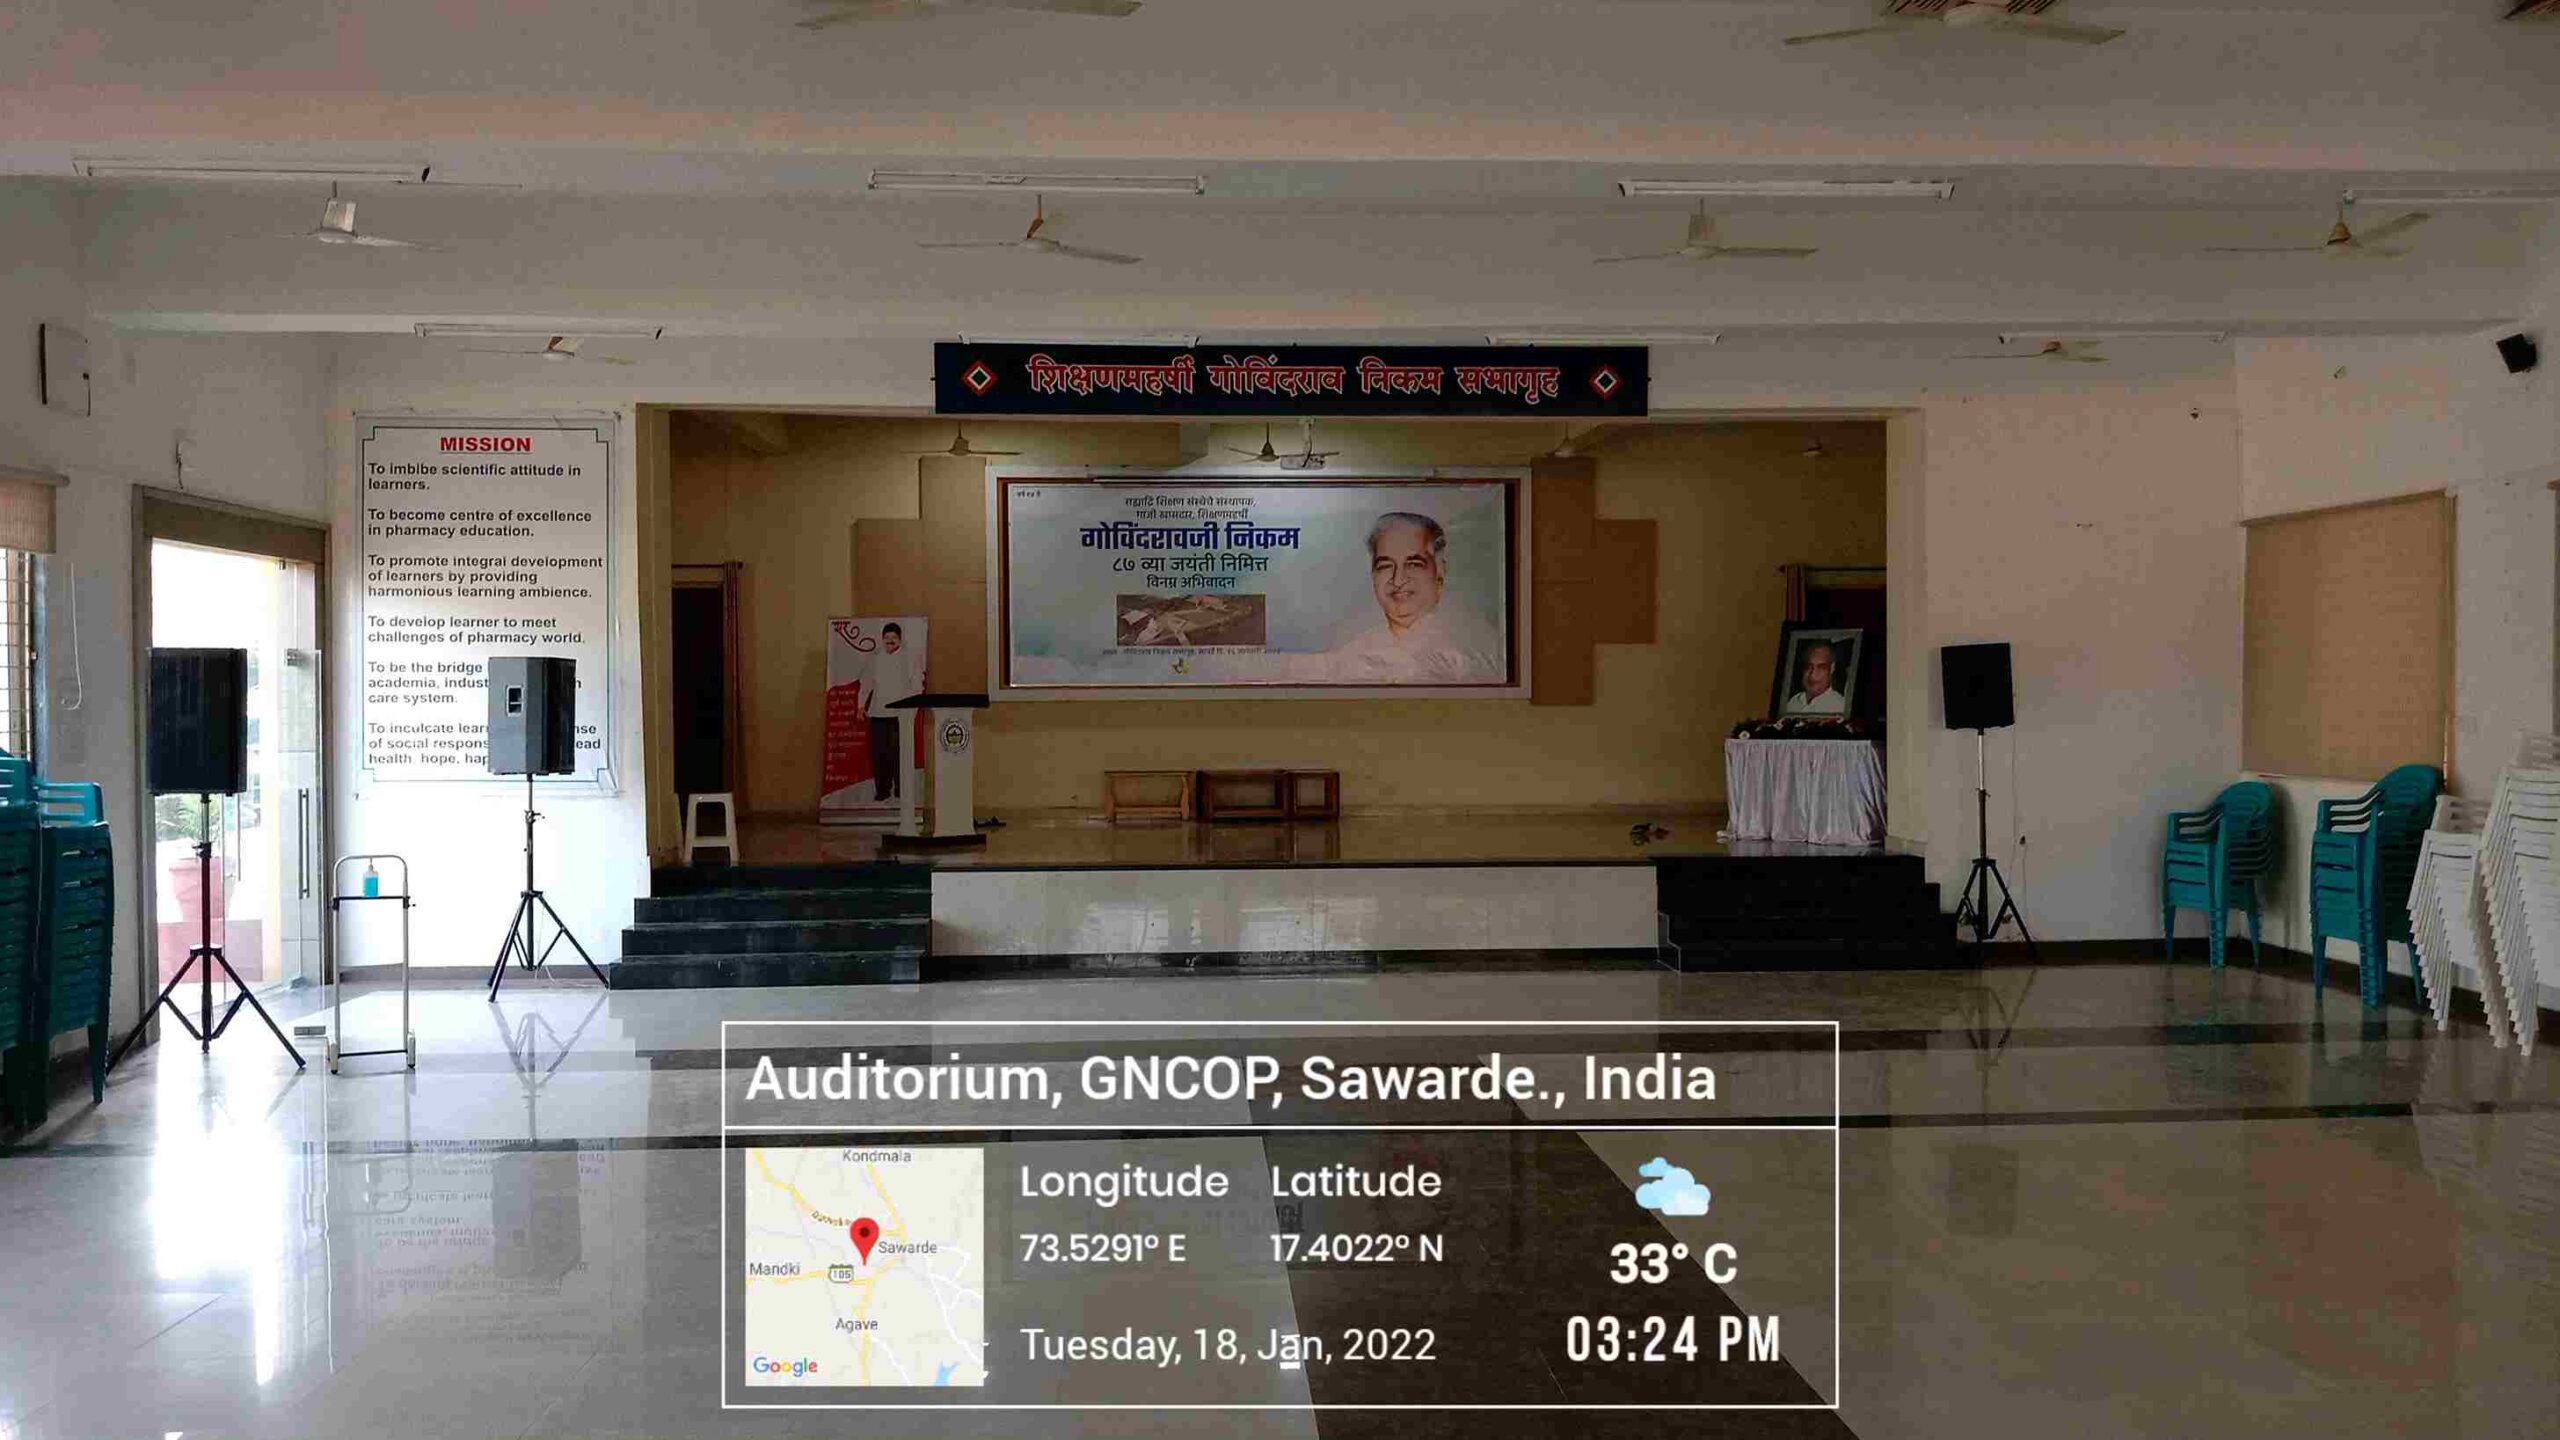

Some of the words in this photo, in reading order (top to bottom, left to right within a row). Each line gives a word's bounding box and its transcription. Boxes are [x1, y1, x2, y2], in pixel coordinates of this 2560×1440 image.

[1024, 353, 1196, 396] शिक्षणमहर्षी
[1206, 353, 1346, 398] गोविंदराव
[1356, 355, 1444, 396] निकम
[1453, 366, 1560, 404] सभागृह
[439, 436, 533, 453] MISSION
[368, 463, 386, 475] To
[389, 463, 437, 475] imbibe
[441, 463, 507, 476] scientific
[510, 464, 564, 476] attitude
[568, 465, 582, 476] in
[368, 478, 430, 490] learners.
[368, 509, 386, 520] To
[389, 509, 445, 521] become
[449, 510, 495, 521] centre
[499, 509, 514, 521] of
[516, 510, 592, 522] excellence
[368, 525, 381, 536] in
[386, 525, 456, 539] pharmacy
[460, 525, 535, 538] education.
[1079, 521, 1221, 550] गोविंदरावजी
[1223, 521, 1301, 550] निकम
[368, 555, 386, 566] To
[389, 556, 449, 569] promote
[452, 556, 507, 569] integral
[510, 556, 603, 570] development
[1112, 557, 1136, 572] ८७
[1140, 556, 1165, 572] व्या
[1170, 552, 1216, 572] जयंती
[1220, 552, 1269, 572] निमित्त
[368, 570, 382, 581] of
[386, 571, 444, 582] learners
[448, 571, 466, 583] by
[469, 572, 538, 584] providing
[1179, 574, 1236, 589] अभिवादन
[368, 585, 454, 597] harmonious
[457, 587, 516, 599] learning
[519, 587, 593, 598] ambience.
[368, 616, 386, 627] To
[389, 616, 446, 629] develop
[449, 616, 500, 628] learner
[503, 617, 518, 628] to
[522, 617, 557, 628] meet
[368, 632, 446, 645] challenges
[449, 632, 464, 644] of
[467, 632, 538, 645] pharmacy
[541, 633, 586, 644] world.
[368, 662, 386, 673] To
[389, 662, 407, 673] be
[411, 662, 434, 673] the
[437, 662, 483, 675] bridge
[368, 693, 399, 704] care
[368, 723, 386, 734] To
[389, 723, 454, 734] inculcate
[368, 738, 383, 750] of
[387, 738, 430, 750] social
